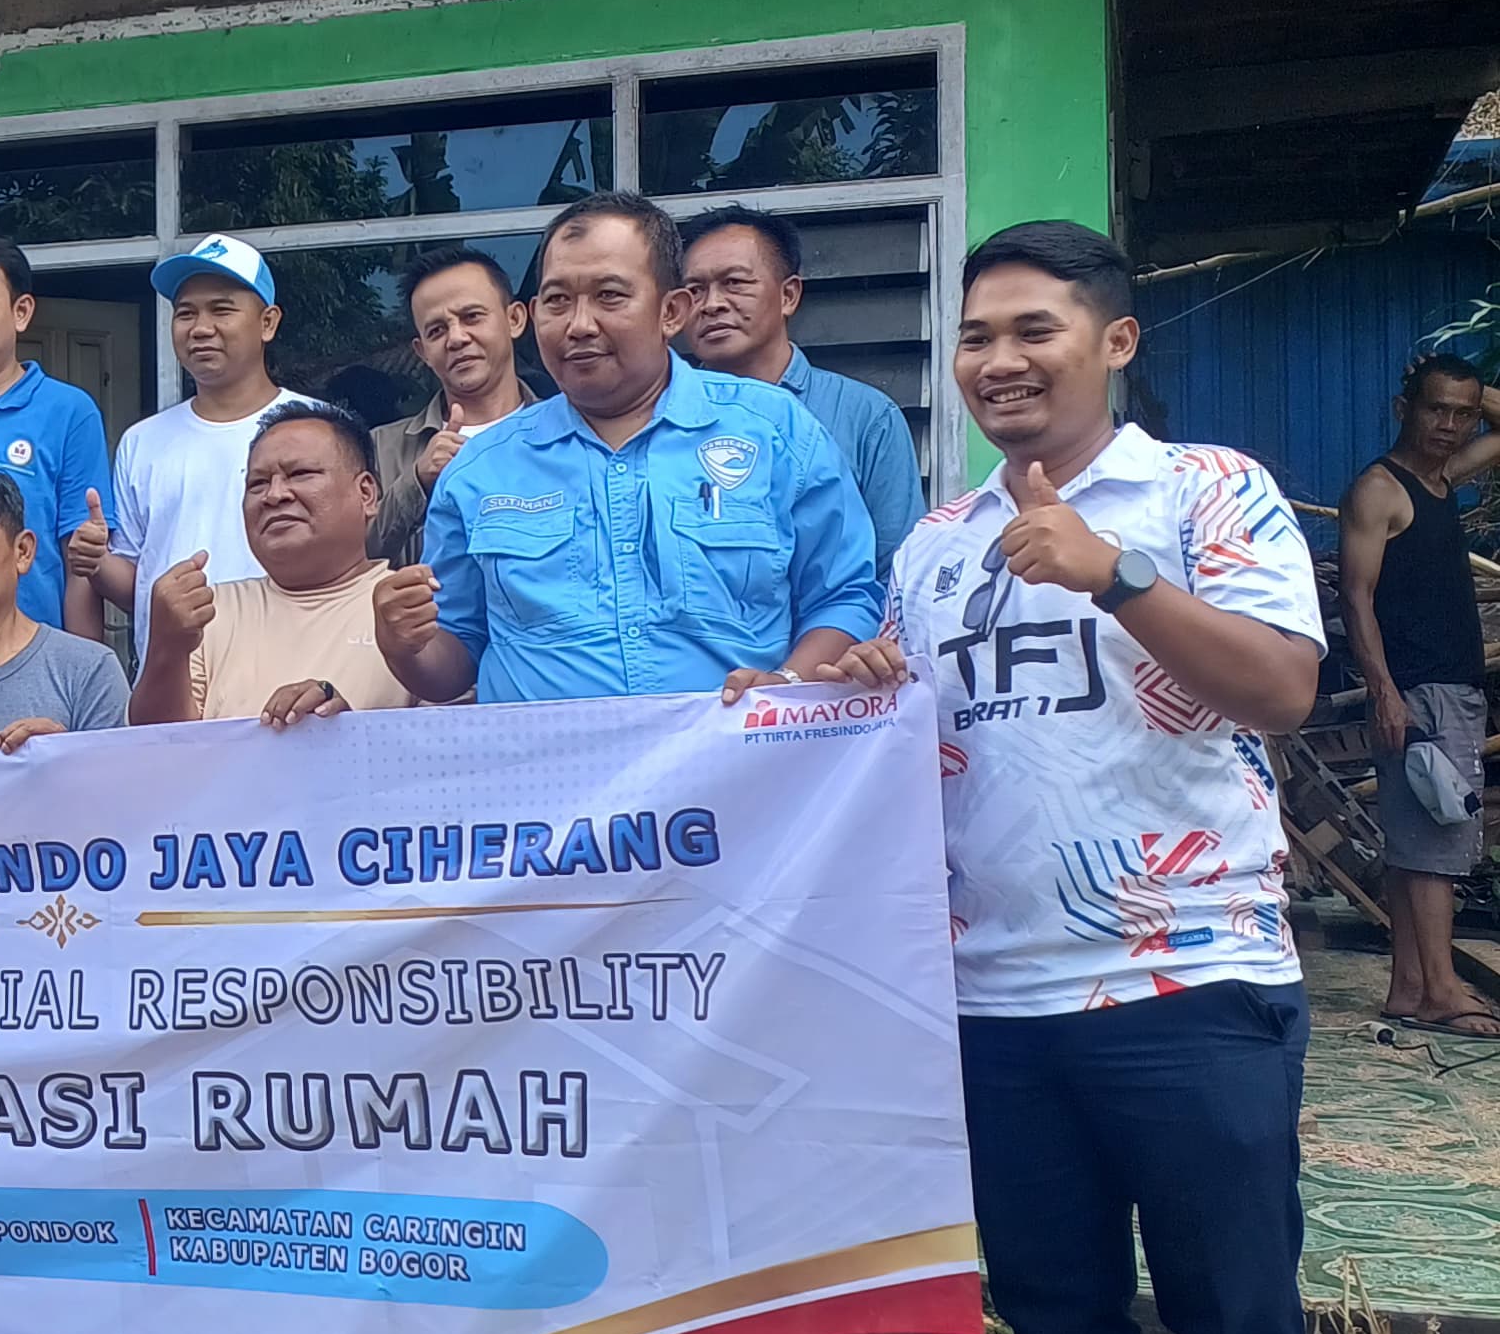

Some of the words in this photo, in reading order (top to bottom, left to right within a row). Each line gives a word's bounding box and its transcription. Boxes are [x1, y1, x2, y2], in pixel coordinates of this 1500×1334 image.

[938, 617, 1106, 714] TFJ
[781, 693, 898, 726] MAYORA
[1037, 695, 1051, 716] 1
[744, 733, 761, 745] PT
[763, 730, 803, 743] TIRTA
[804, 724, 871, 740] FRESINDO
[149, 831, 314, 891] JAYA
[337, 806, 721, 887] CIHERANG
[128, 952, 726, 1032] RESPONSIBILITY
[191, 1068, 588, 1159] RUMAH
[164, 1207, 352, 1239] KECAMATAN
[363, 1214, 526, 1251] CARINGIN
[169, 1237, 349, 1272] KABUPATEN
[358, 1247, 471, 1282] BOGOR
